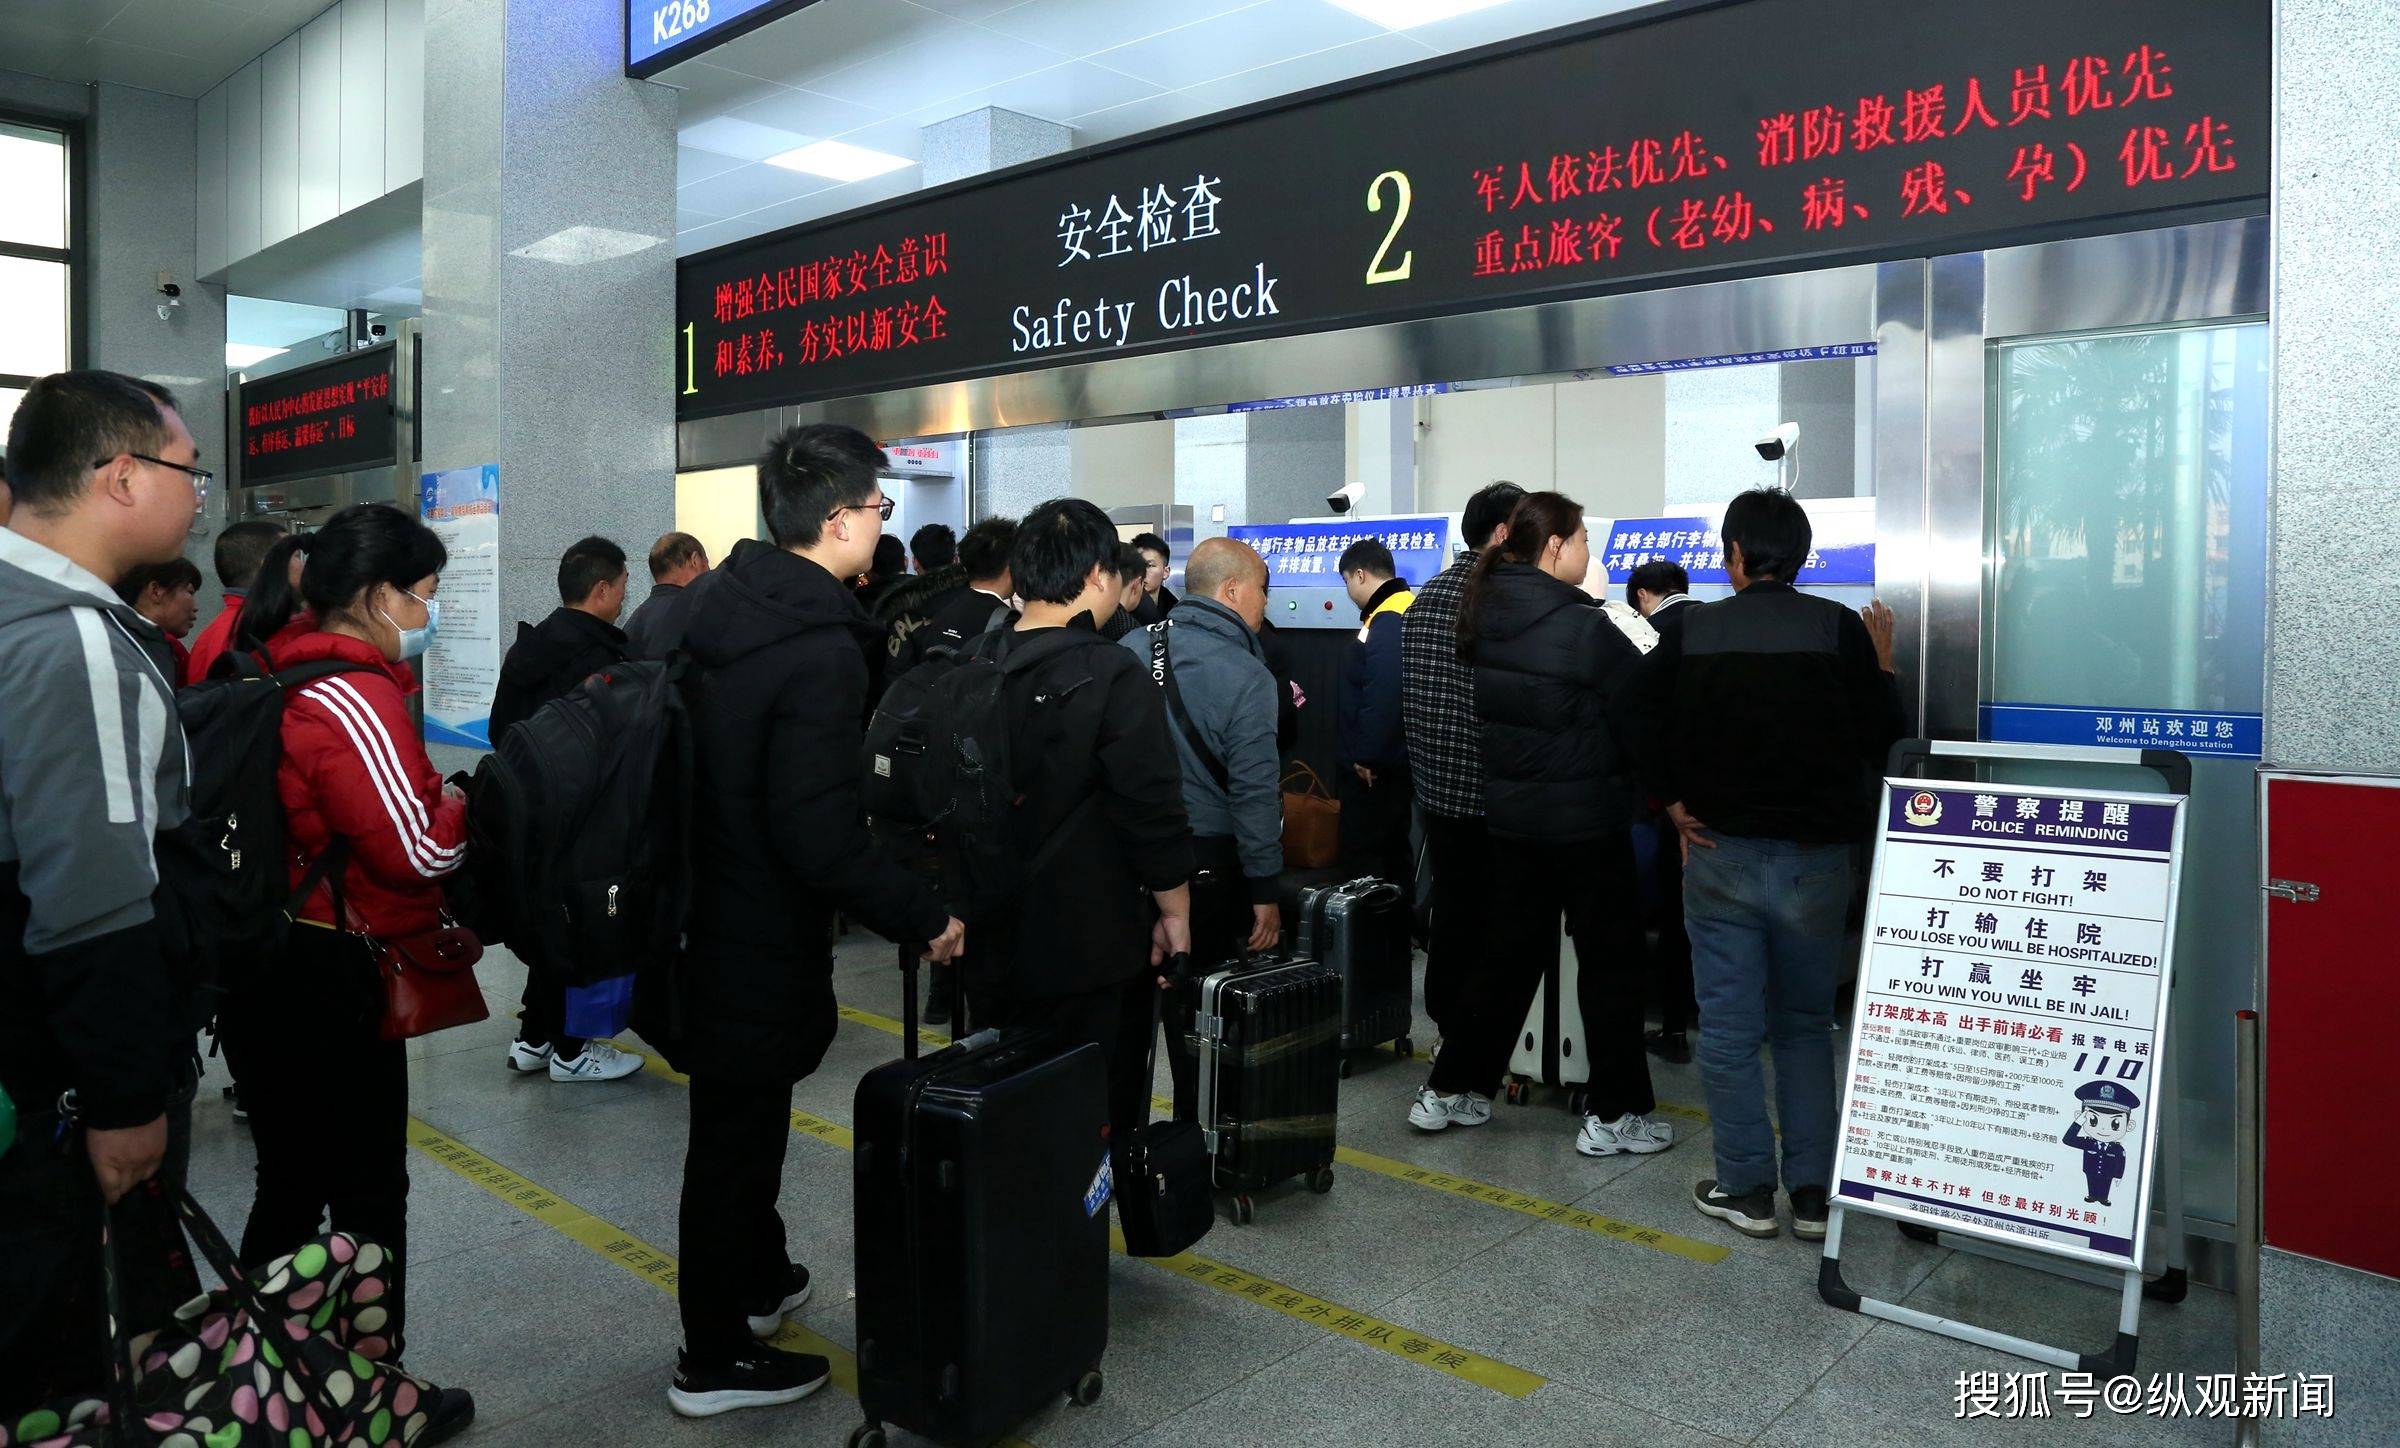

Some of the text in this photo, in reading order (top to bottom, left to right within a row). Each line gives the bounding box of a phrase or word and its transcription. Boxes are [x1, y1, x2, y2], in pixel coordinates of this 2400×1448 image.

[653, 0, 710, 45] K268
[1056, 174, 1223, 268] 安全检查
[1367, 170, 1413, 286] 2
[713, 231, 949, 324] 增强全民国家安全意识
[1012, 263, 1280, 354] Safety Check
[682, 321, 698, 395] 1
[714, 295, 949, 378] 和素养，夯实以新安全
[2096, 716, 2234, 739] 邓州站欢迎您
[2096, 735, 2233, 749] Welcome to Dengzhou station
[1971, 819, 2129, 842] POLICE REMINDING
[1974, 794, 2130, 826] 警察提醒
[1933, 858, 2108, 893] 不要打架
[1958, 885, 2073, 908] DO NOT FIGHT!
[1876, 926, 2158, 969] IF YOU LOSE YOU WILL BE HOSPITALIZED!
[1926, 906, 2102, 946] 打输住院
[1920, 955, 2097, 998] 打赢坐牢
[1888, 979, 2130, 1021] IF YOU WIN YOU WILL BE IN JAIL!
[1867, 1001, 2064, 1044] 打架成本高 出手前请必看
[2071, 1032, 2150, 1057] 报警电话
[2073, 1052, 2144, 1081] 110
[1865, 1166, 1973, 1199] 警察过年不打烊
[1402, 1168, 1662, 1245] 请在黄线外排队等候
[1184, 1261, 1469, 1370] 请在黄线外排队等候
